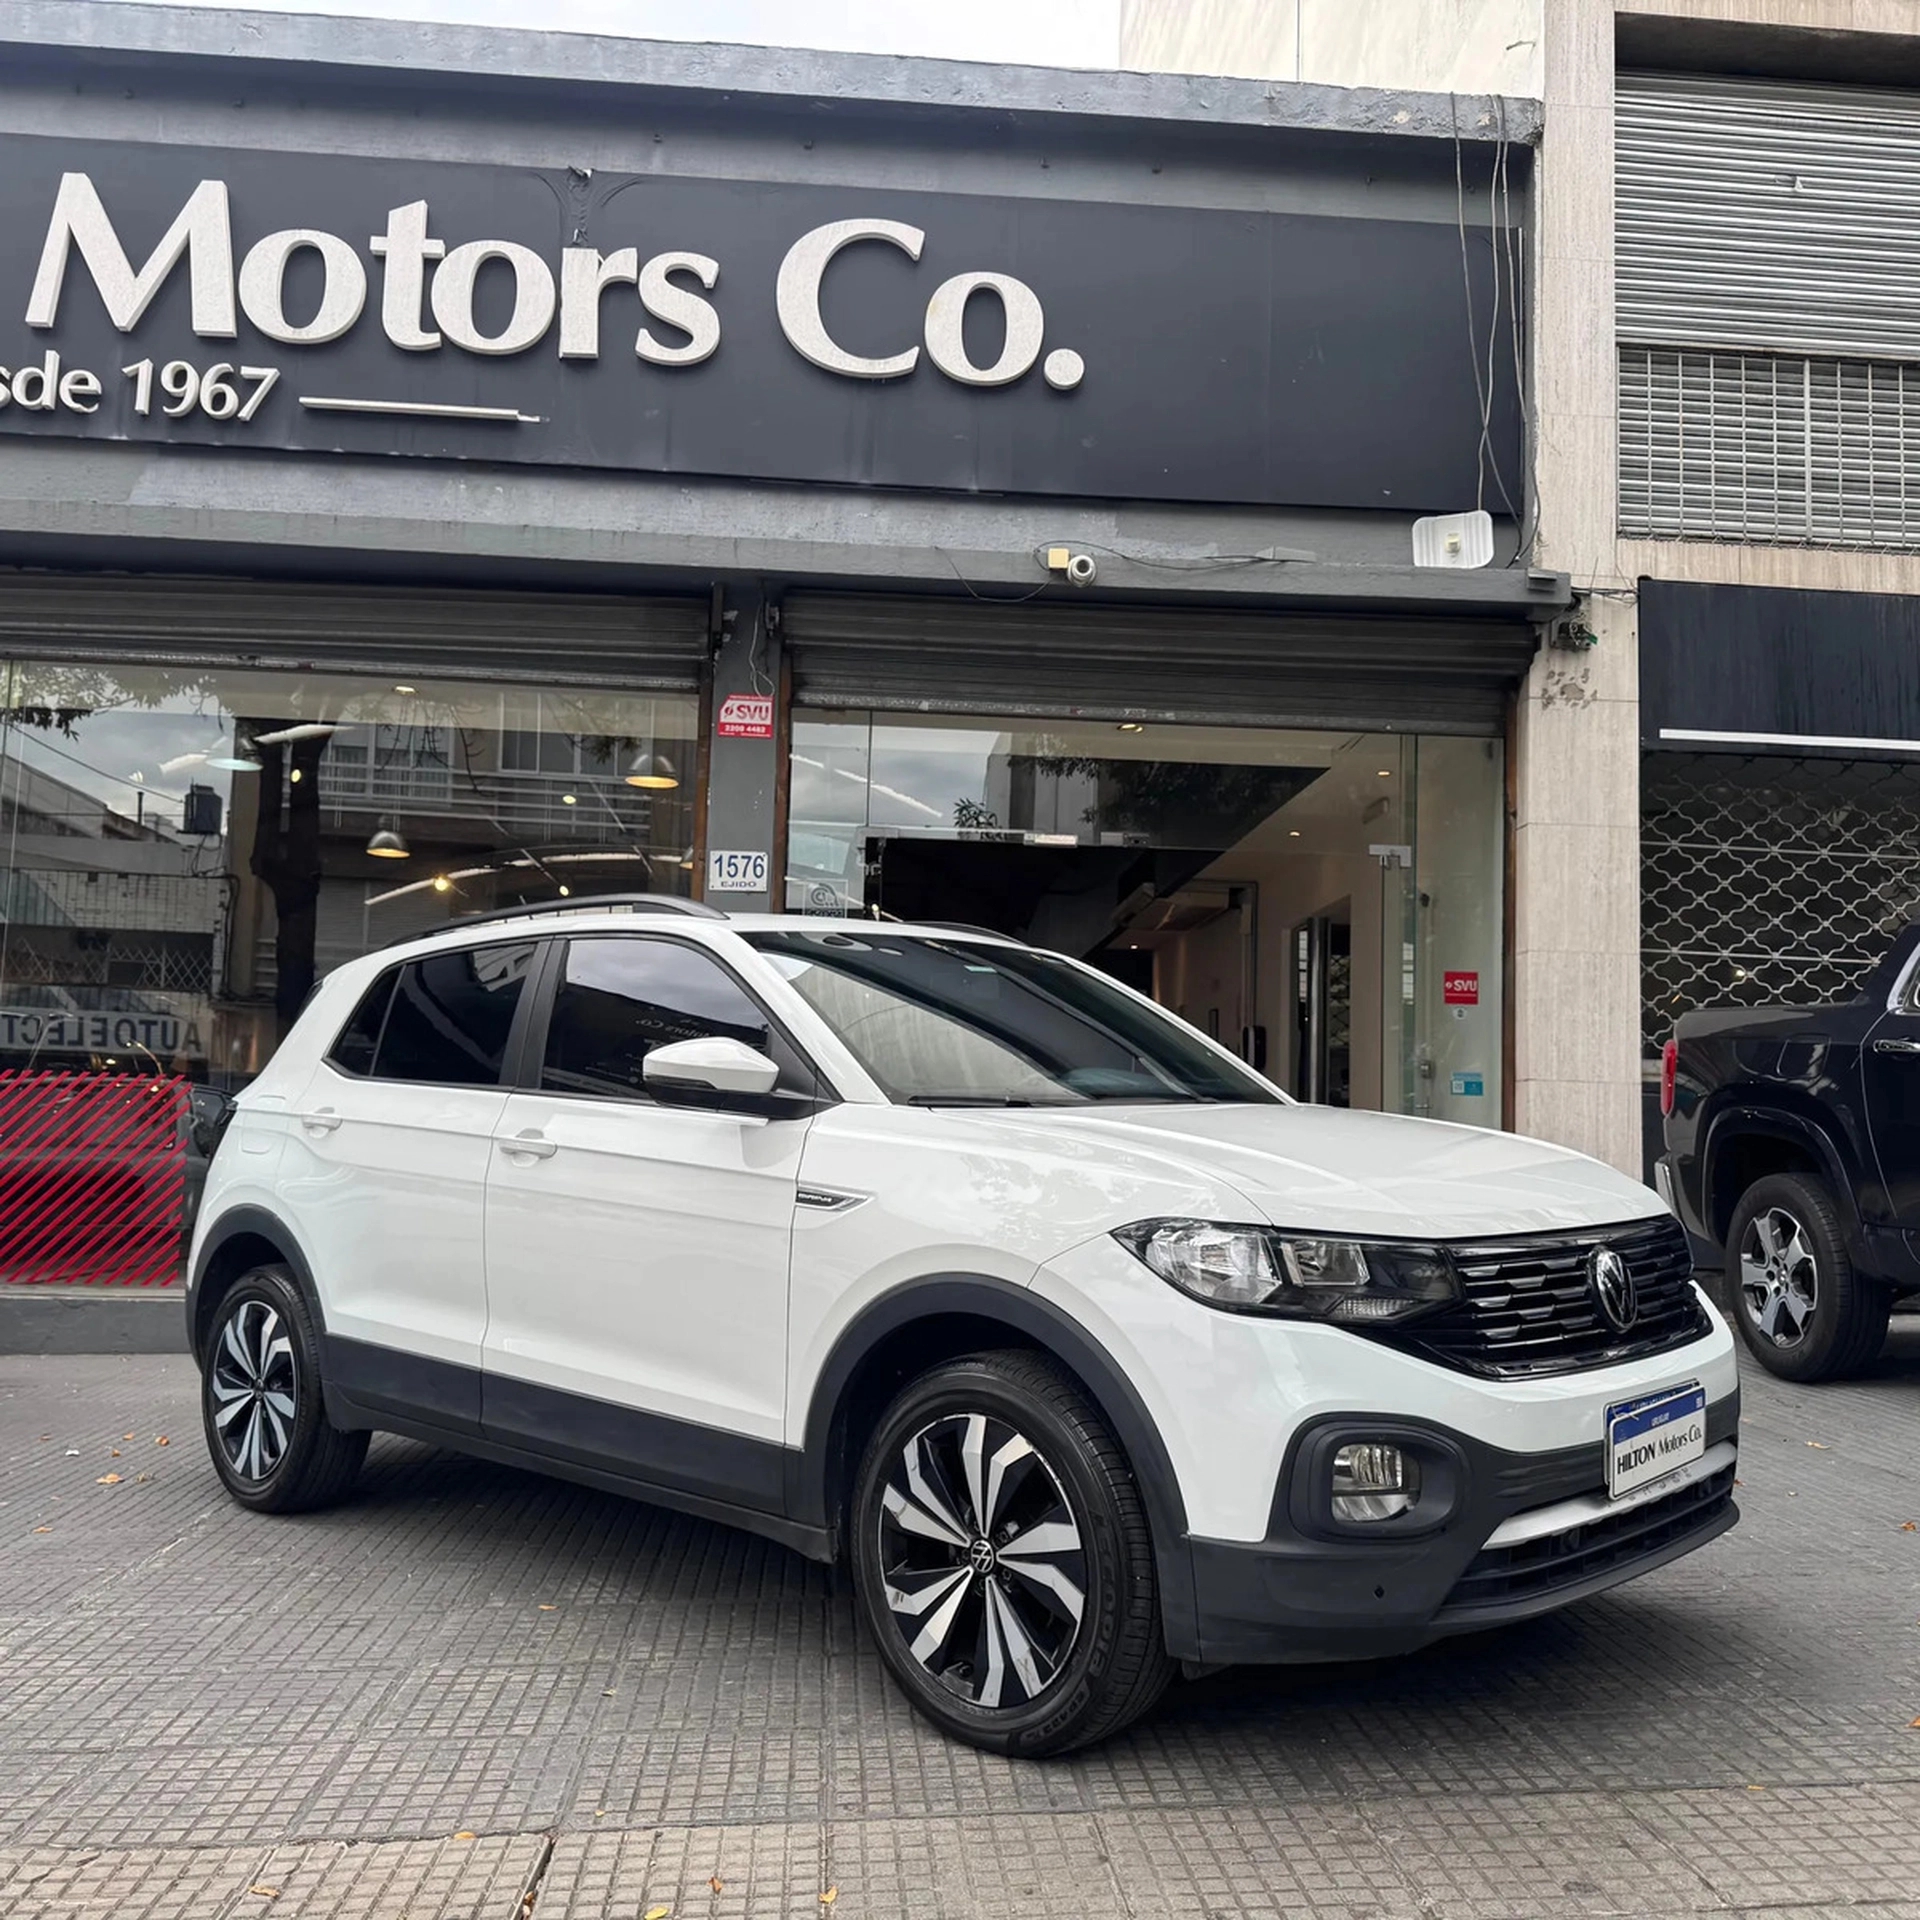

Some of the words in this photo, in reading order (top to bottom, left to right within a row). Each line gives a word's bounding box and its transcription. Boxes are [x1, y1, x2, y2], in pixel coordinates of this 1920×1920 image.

[25, 172, 721, 366] Motors
[776, 218, 1085, 390] Co.
[121, 358, 280, 422] 1967
[736, 704, 769, 721] SVU
[714, 854, 765, 879] 1576
[1453, 980, 1478, 992] SVU
[1617, 1441, 1656, 1475] HILTON
[1657, 1432, 1688, 1458] Motors
[1688, 1423, 1703, 1443] Co.
